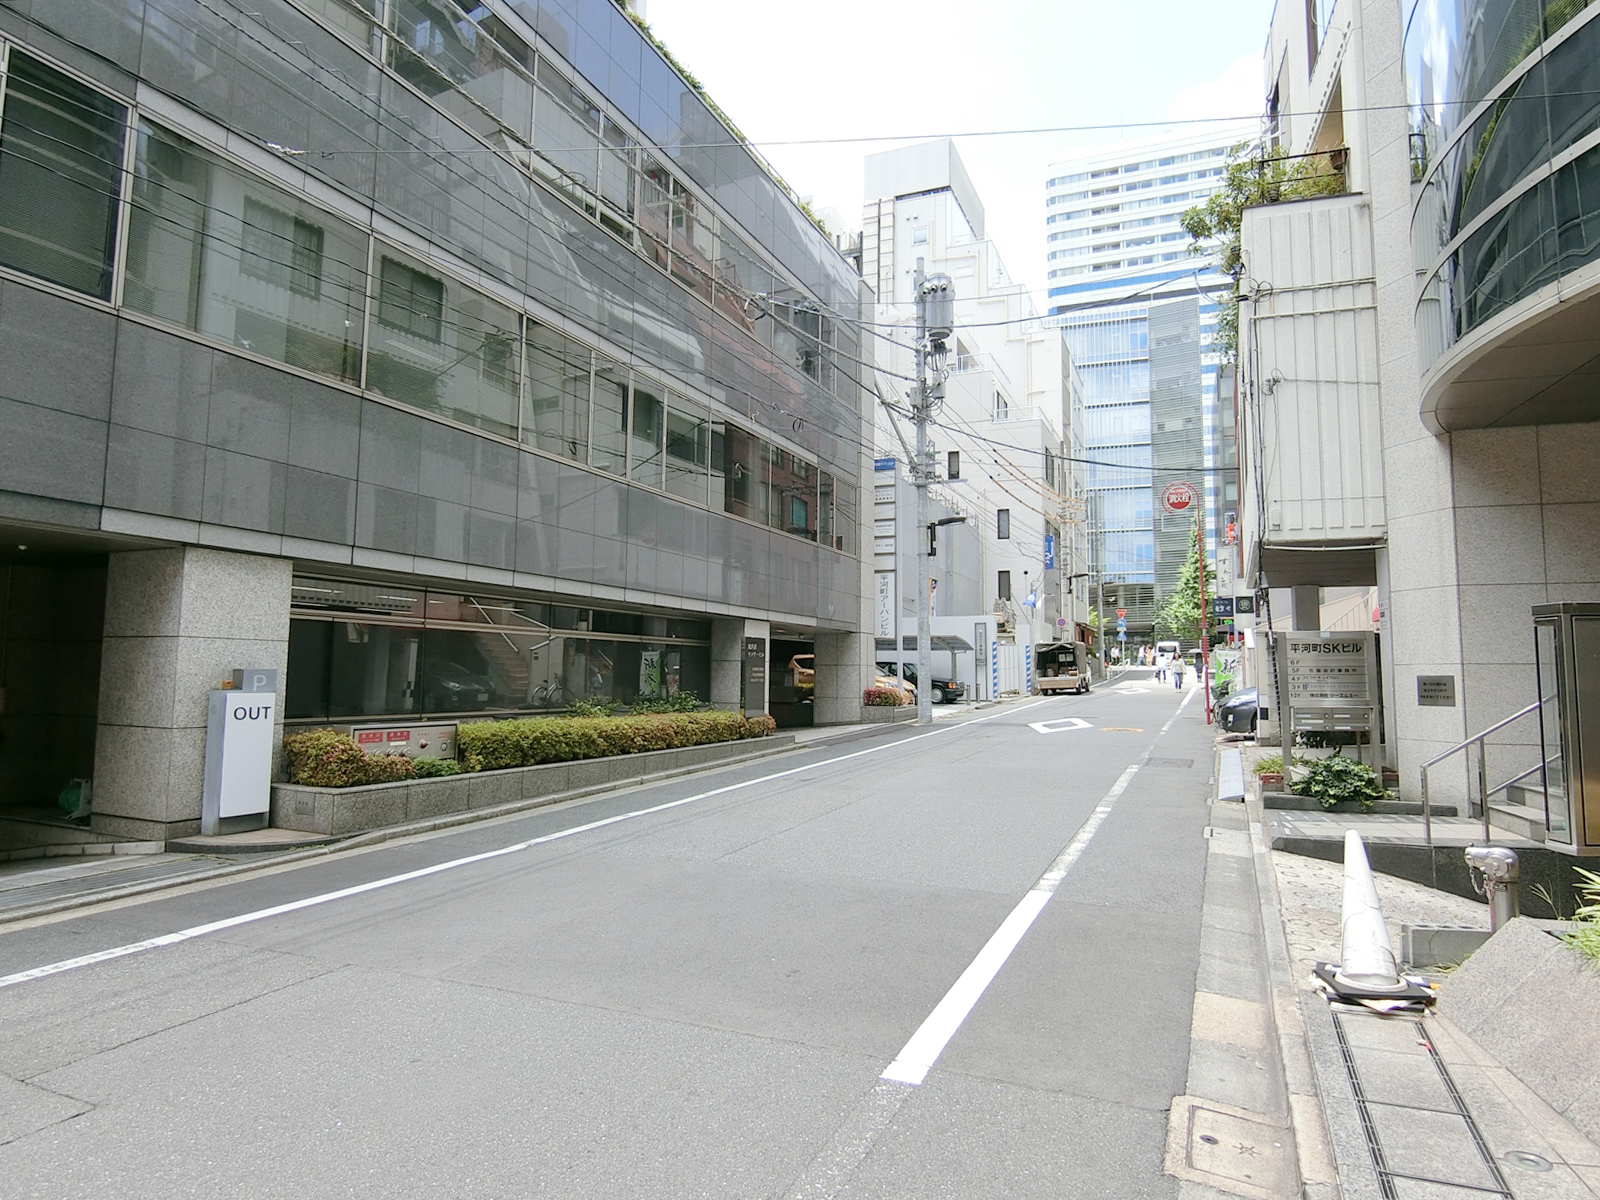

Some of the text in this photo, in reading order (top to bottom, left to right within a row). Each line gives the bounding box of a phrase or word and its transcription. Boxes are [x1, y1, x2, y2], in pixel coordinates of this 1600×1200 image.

[1168, 492, 1190, 503] 消火栓
[879, 574, 889, 637] 平河町アーバンビル
[1290, 643, 1362, 654] 平河町SKビル
[253, 674, 267, 692] P
[233, 706, 272, 721] OUT
